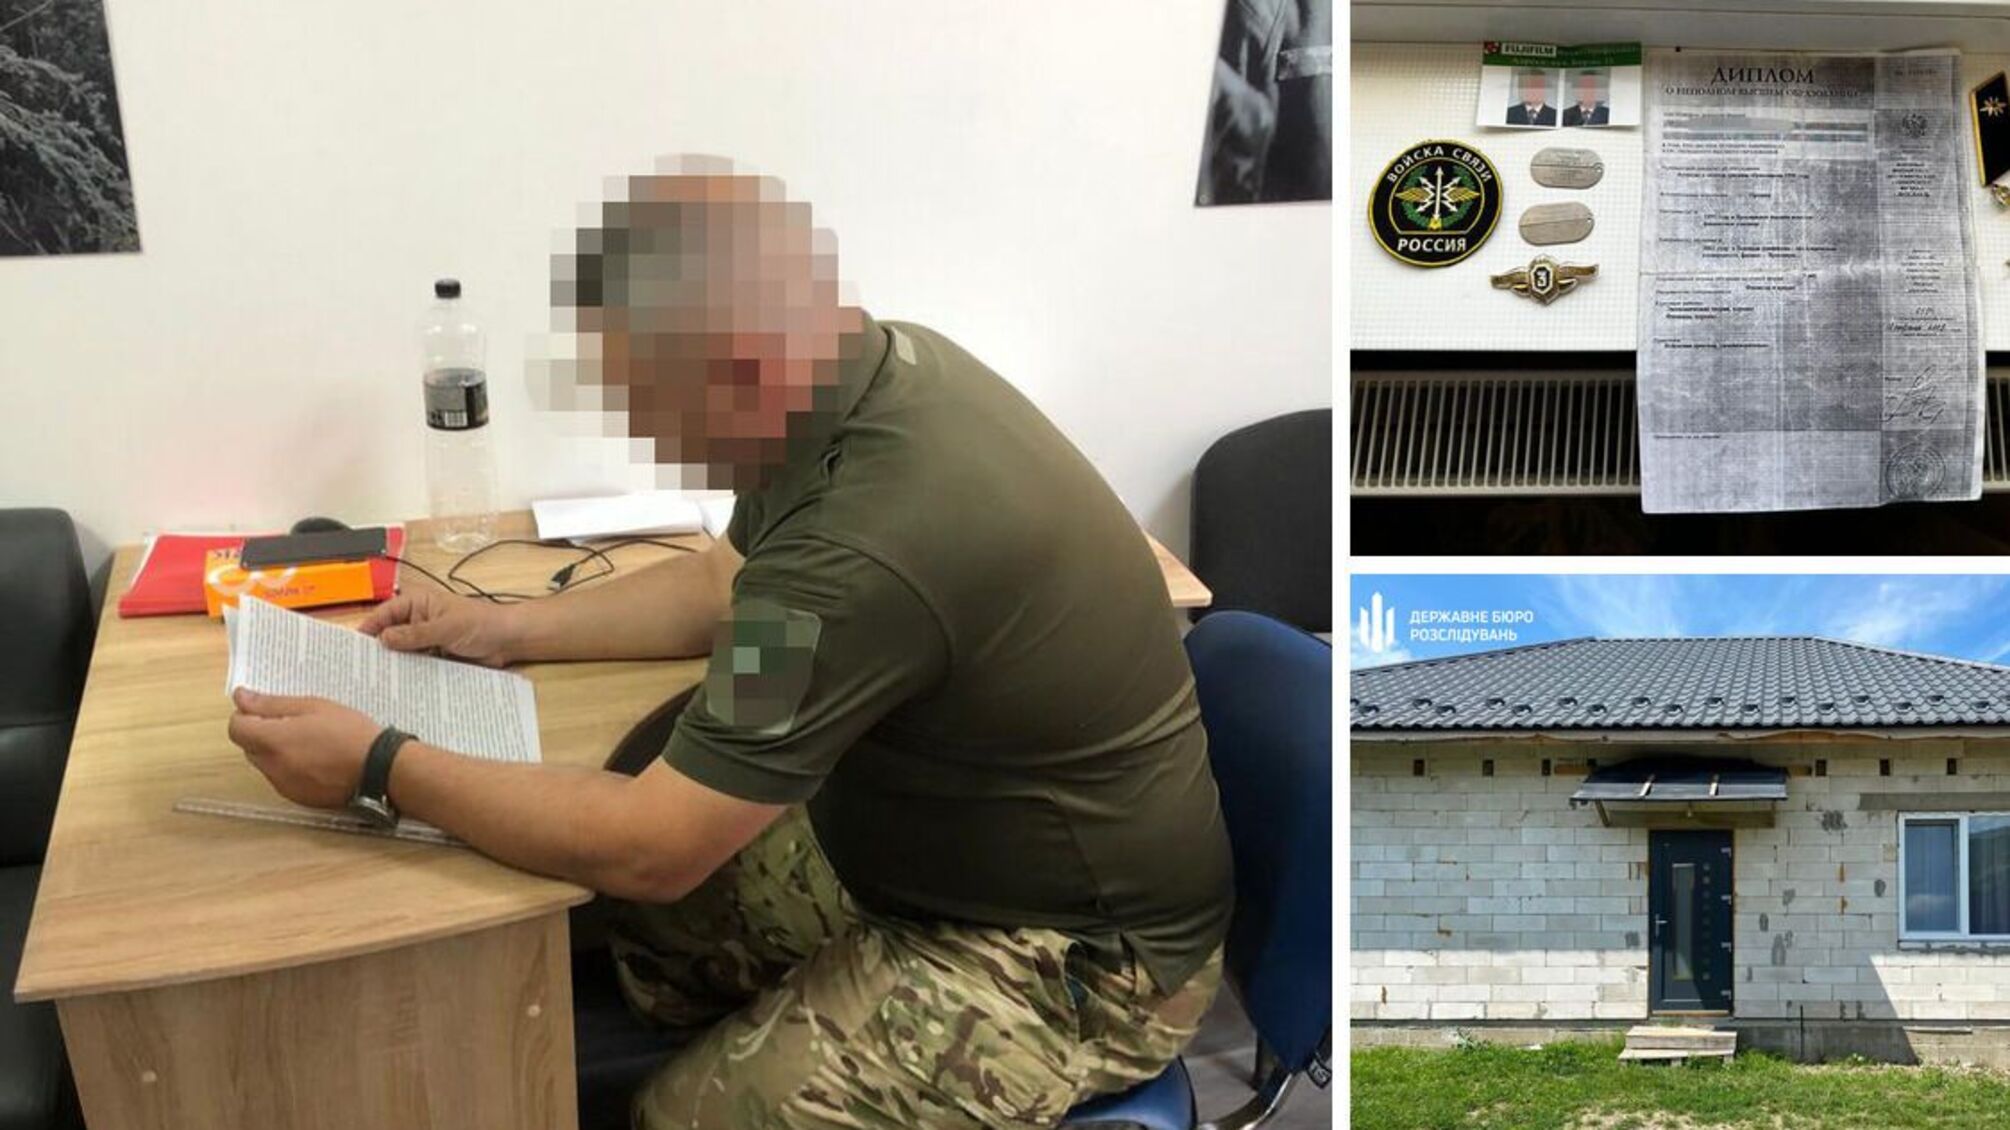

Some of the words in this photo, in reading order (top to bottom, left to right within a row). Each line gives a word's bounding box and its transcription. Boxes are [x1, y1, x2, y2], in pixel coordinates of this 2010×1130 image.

[1710, 66, 1814, 86] ДИПЛОМ
[1387, 146, 1445, 183] ВОЙСКА
[1452, 148, 1493, 183] СВЯЗИ
[1397, 237, 1468, 252] РОССИЯ
